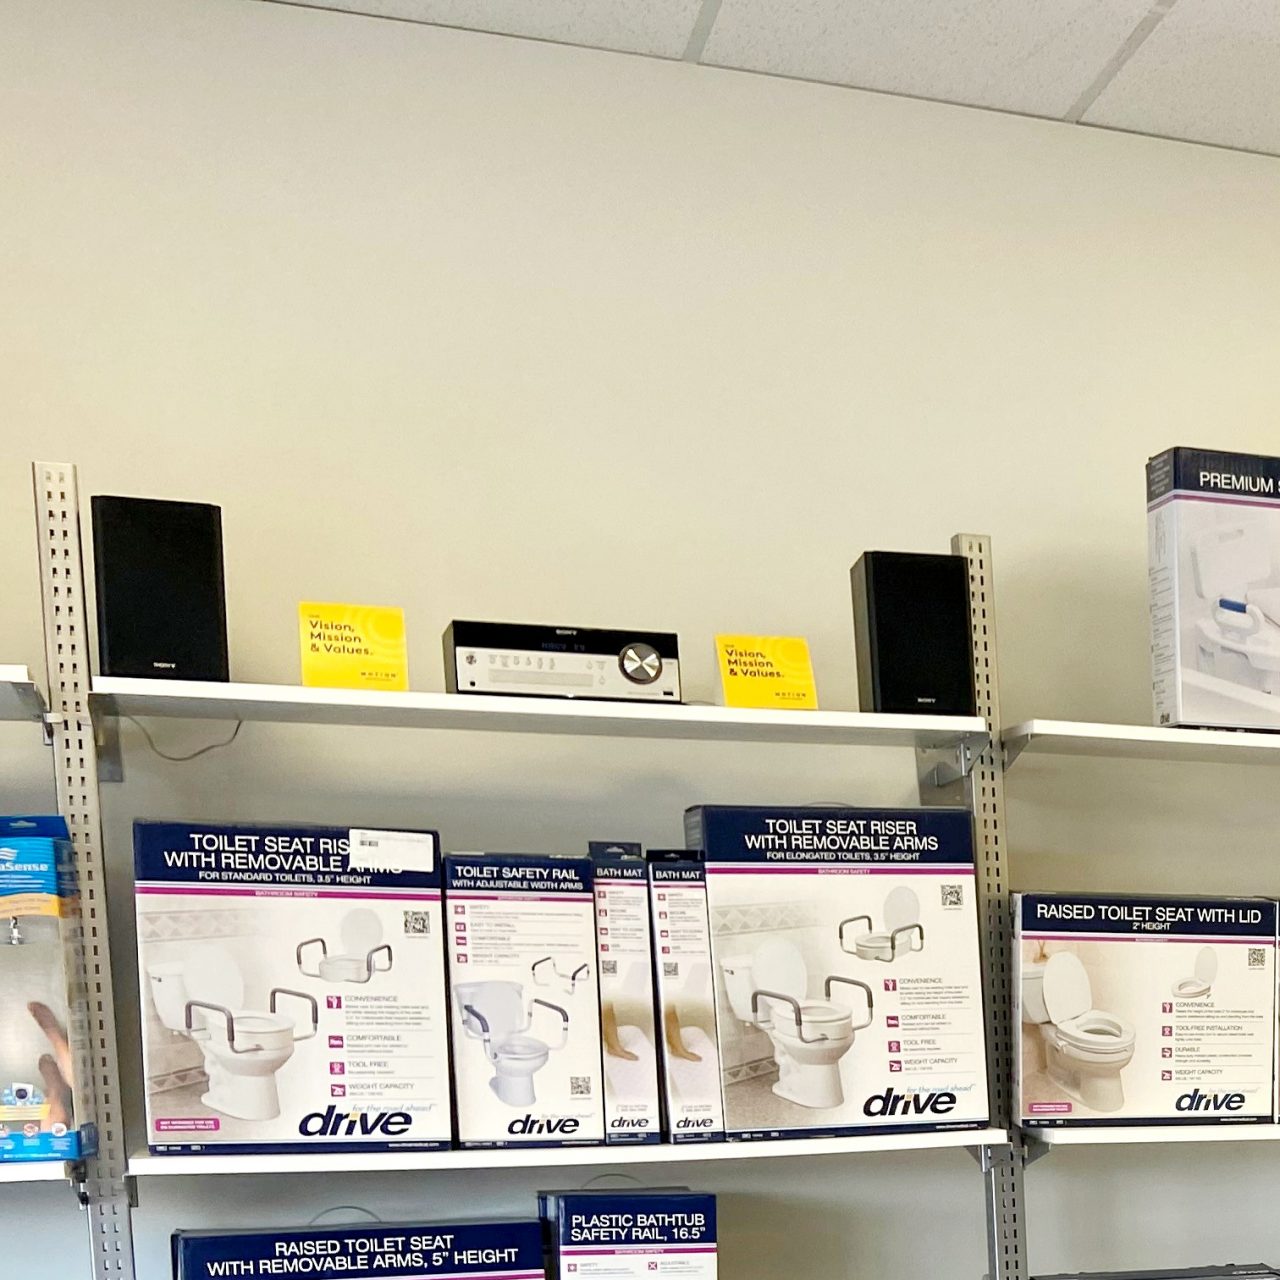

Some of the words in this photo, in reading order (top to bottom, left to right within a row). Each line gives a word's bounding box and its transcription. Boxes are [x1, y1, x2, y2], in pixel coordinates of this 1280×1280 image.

[1200, 472, 1274, 493] PREMIUM
[309, 621, 355, 632] Vision,
[310, 632, 362, 643] Mission
[311, 643, 320, 652] &
[324, 644, 374, 656] Values.
[726, 649, 766, 659] Vision,
[727, 658, 774, 668] Mission
[729, 668, 738, 677] &
[741, 668, 784, 678] Values.
[766, 818, 822, 834] TOILET
[826, 820, 868, 834] SEAT
[871, 821, 916, 834] RISER
[190, 834, 259, 852] TOILET
[264, 838, 314, 854] SEAT
[320, 839, 350, 854] RIS
[744, 835, 787, 849] WITH
[792, 836, 890, 850] REMOVABLE
[892, 836, 938, 850] ARMS
[164, 852, 216, 868] WITH
[222, 853, 342, 872] REMOVABLE
[766, 852, 784, 860] FOR
[786, 852, 836, 860] ELONGATED
[838, 852, 872, 862] TOILETS,
[890, 852, 920, 861] HEIGHT
[199, 872, 219, 880] FOR
[222, 872, 272, 882] STANDARD
[275, 873, 316, 883] TOILETS,
[336, 875, 371, 884] HEIGHT
[455, 866, 499, 878] TOILET
[502, 867, 549, 879] SAFETY
[552, 868, 579, 880] RAIL
[596, 868, 621, 877] BATH
[623, 869, 642, 878] MAT
[655, 870, 679, 880] BATH
[682, 871, 700, 880] MAT
[452, 879, 474, 888] WITH
[475, 880, 528, 889] ADJUSTABLE
[531, 881, 557, 889] WIDTH
[559, 882, 583, 890] ARMS
[1037, 904, 1094, 920] RAISED
[1098, 906, 1152, 921] TOILET
[1155, 908, 1193, 922] SEAT
[1196, 909, 1235, 923] WITH
[1239, 910, 1261, 923] LID
[1141, 923, 1171, 931] HEIGHT
[863, 1088, 956, 1117] drive
[1175, 1089, 1245, 1112] drive
[299, 1104, 412, 1136] drive
[507, 1114, 580, 1135] drive
[611, 1117, 649, 1128] drive
[676, 1117, 714, 1128] drive
[572, 1215, 633, 1228] PLASTIC
[637, 1214, 705, 1227] BATHTUB
[571, 1229, 628, 1242] SAFETY
[631, 1228, 667, 1242] RAIL,
[275, 1240, 340, 1257] RAISED
[345, 1237, 405, 1254] TOILET
[410, 1235, 454, 1251] SEAT
[207, 1260, 253, 1277] WITH
[258, 1255, 369, 1274] REMOVABLE
[374, 1252, 427, 1271] ARMS,
[454, 1248, 518, 1265] HEIGHT
